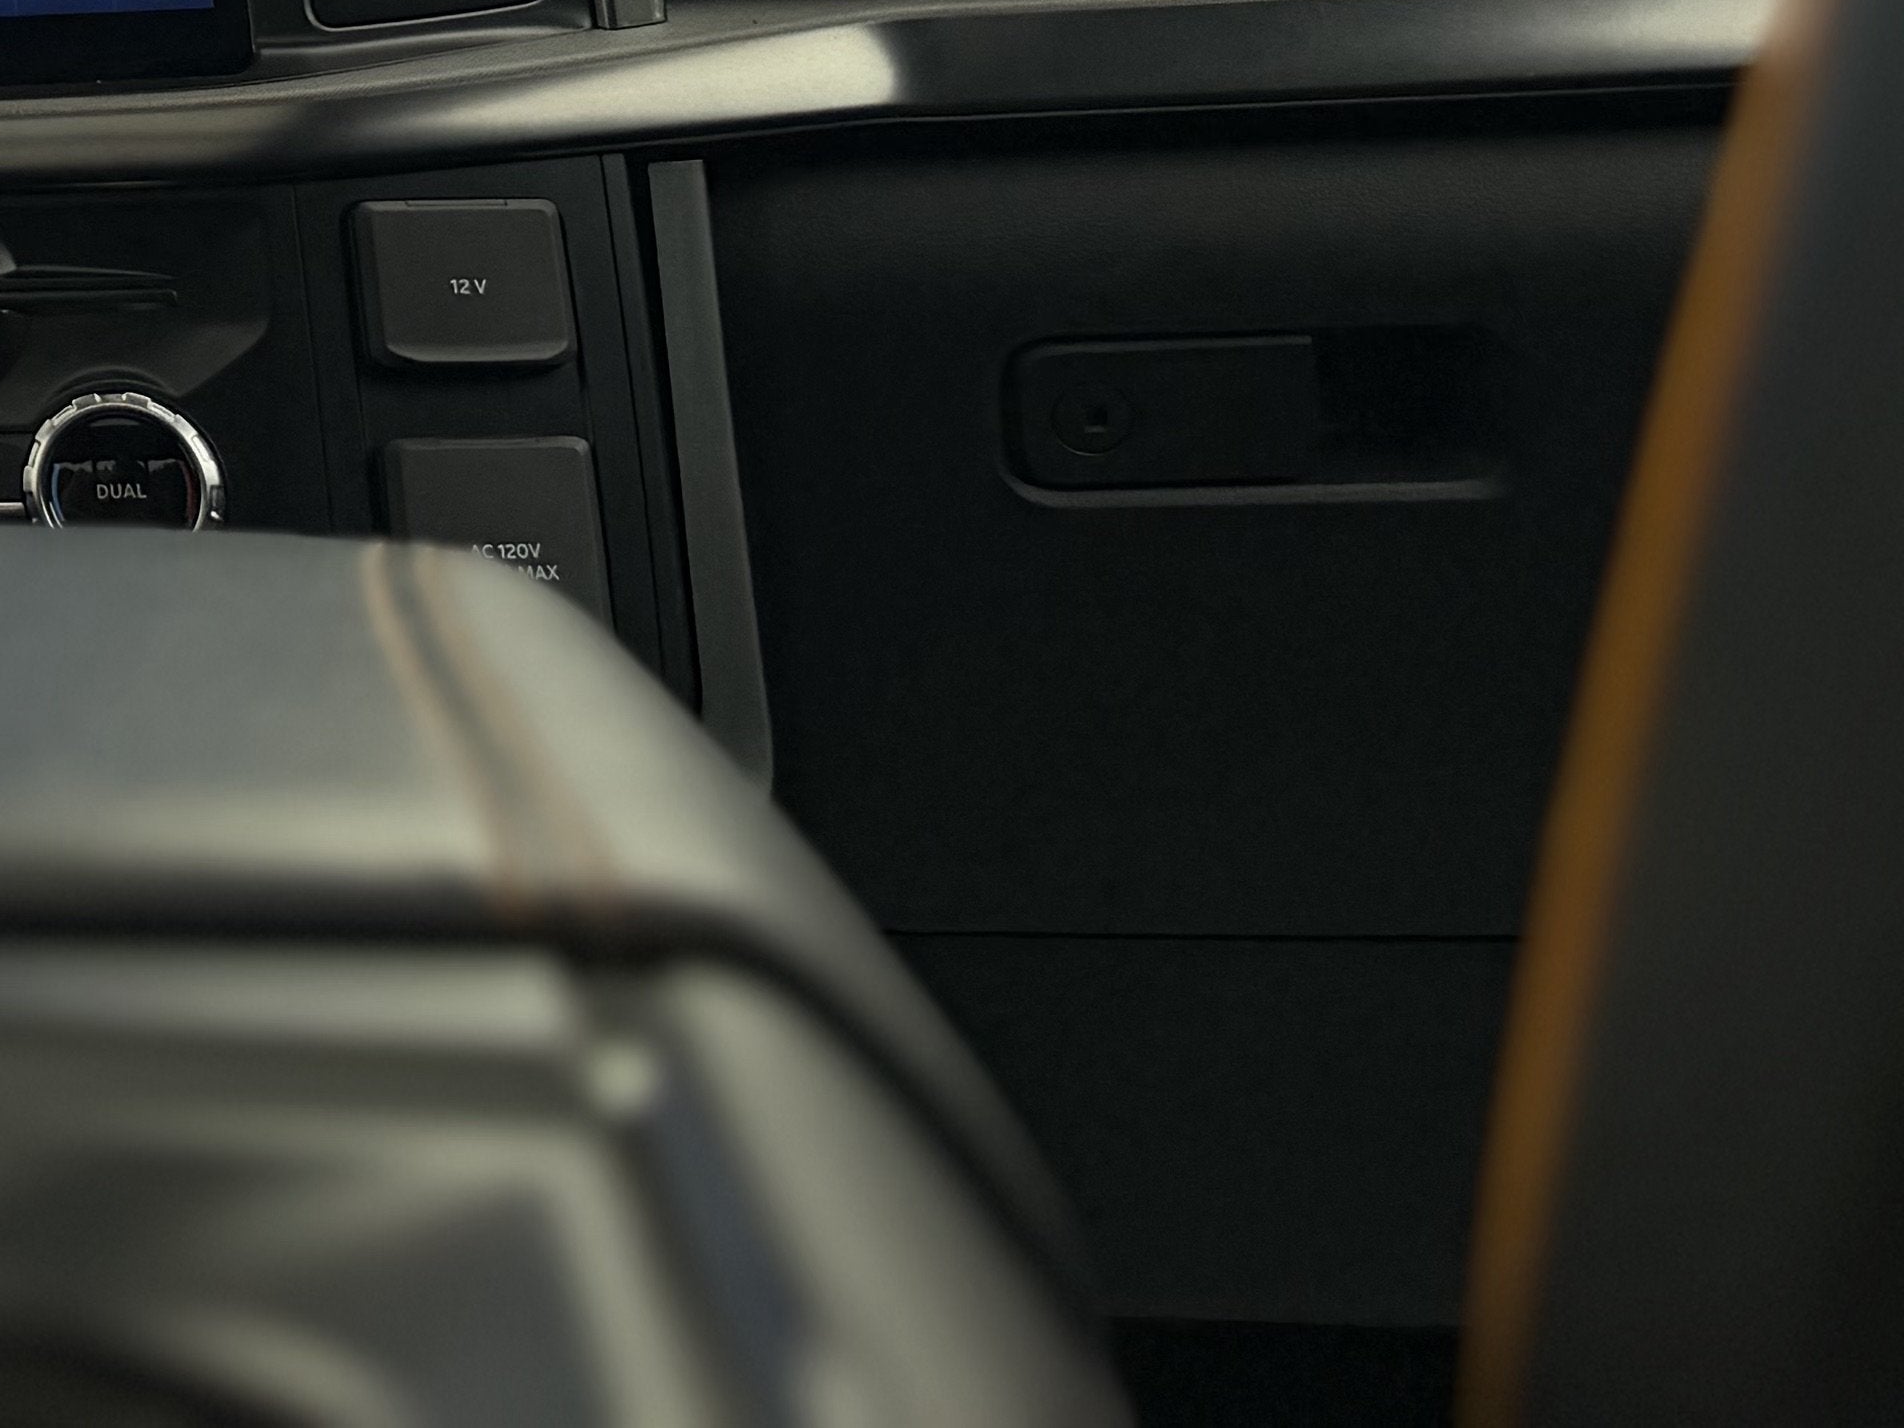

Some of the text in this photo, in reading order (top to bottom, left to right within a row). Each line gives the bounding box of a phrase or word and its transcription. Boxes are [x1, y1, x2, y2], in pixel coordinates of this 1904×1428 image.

[449, 277, 488, 295] 12 V
[96, 482, 148, 501] DUAL
[496, 543, 541, 560] 120V
